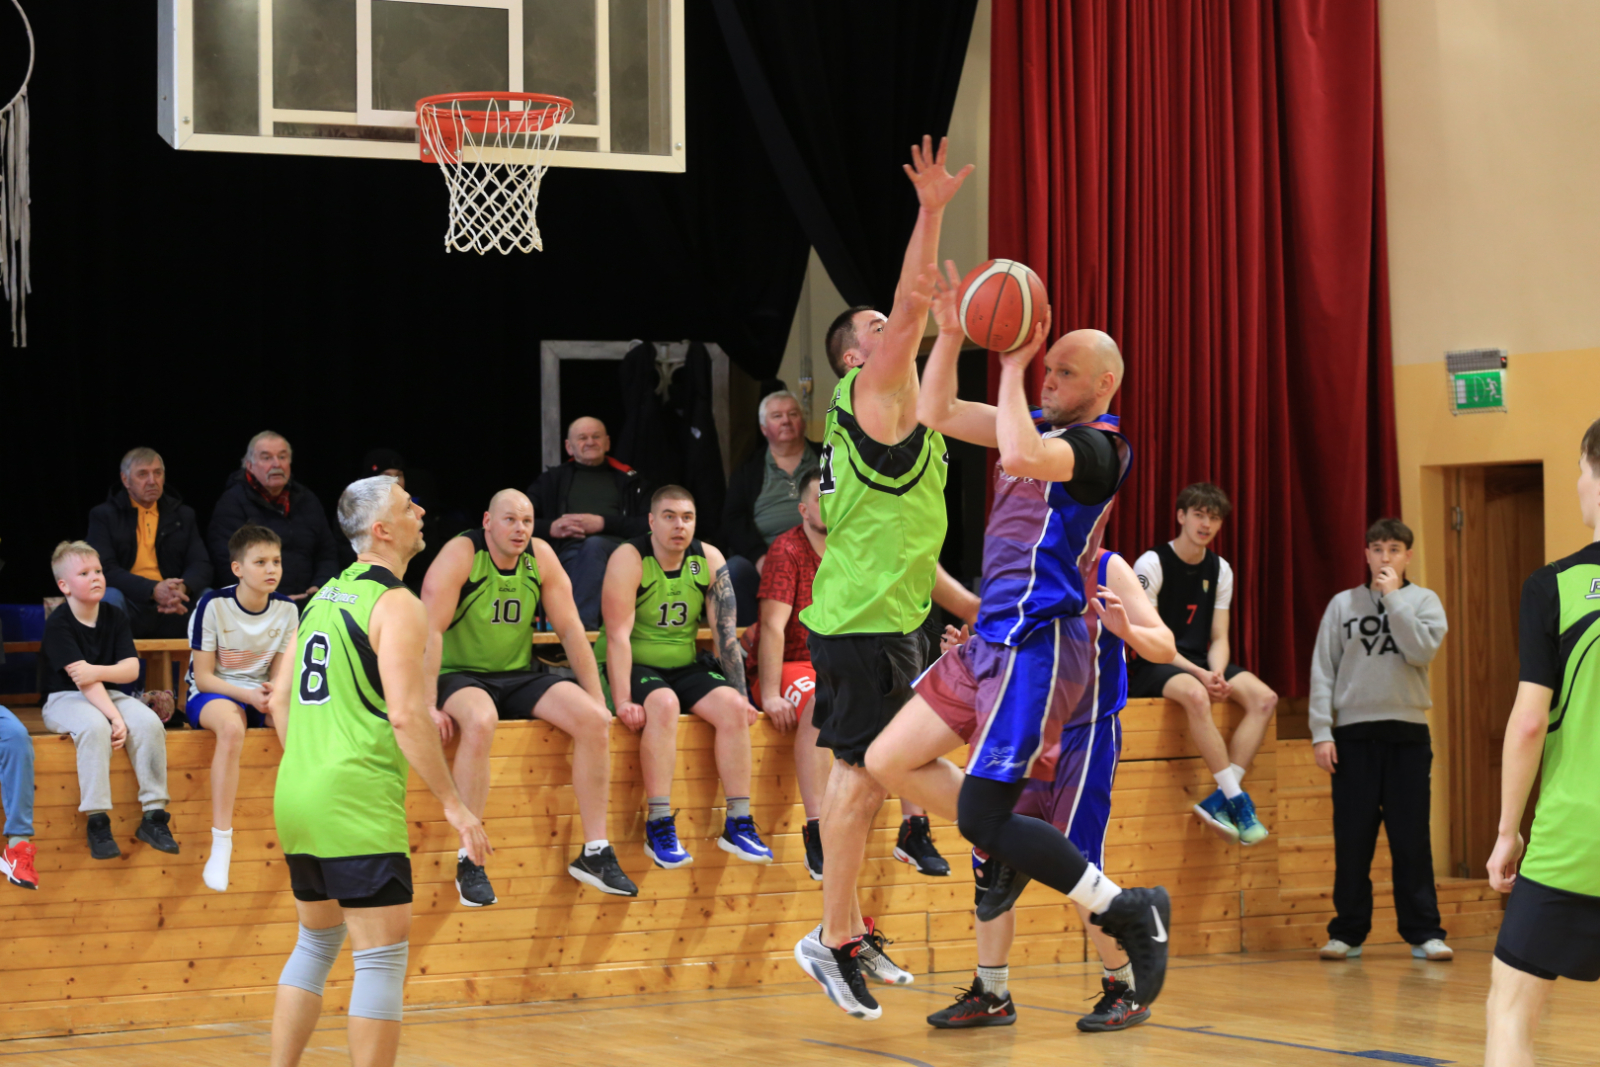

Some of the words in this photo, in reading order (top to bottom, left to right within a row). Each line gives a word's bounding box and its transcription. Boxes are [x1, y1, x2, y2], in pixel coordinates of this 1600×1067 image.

[490, 597, 522, 625] 10
[656, 601, 689, 628] 13
[1186, 604, 1198, 625] 7
[1360, 634, 1400, 656] YA
[298, 630, 332, 706] 8
